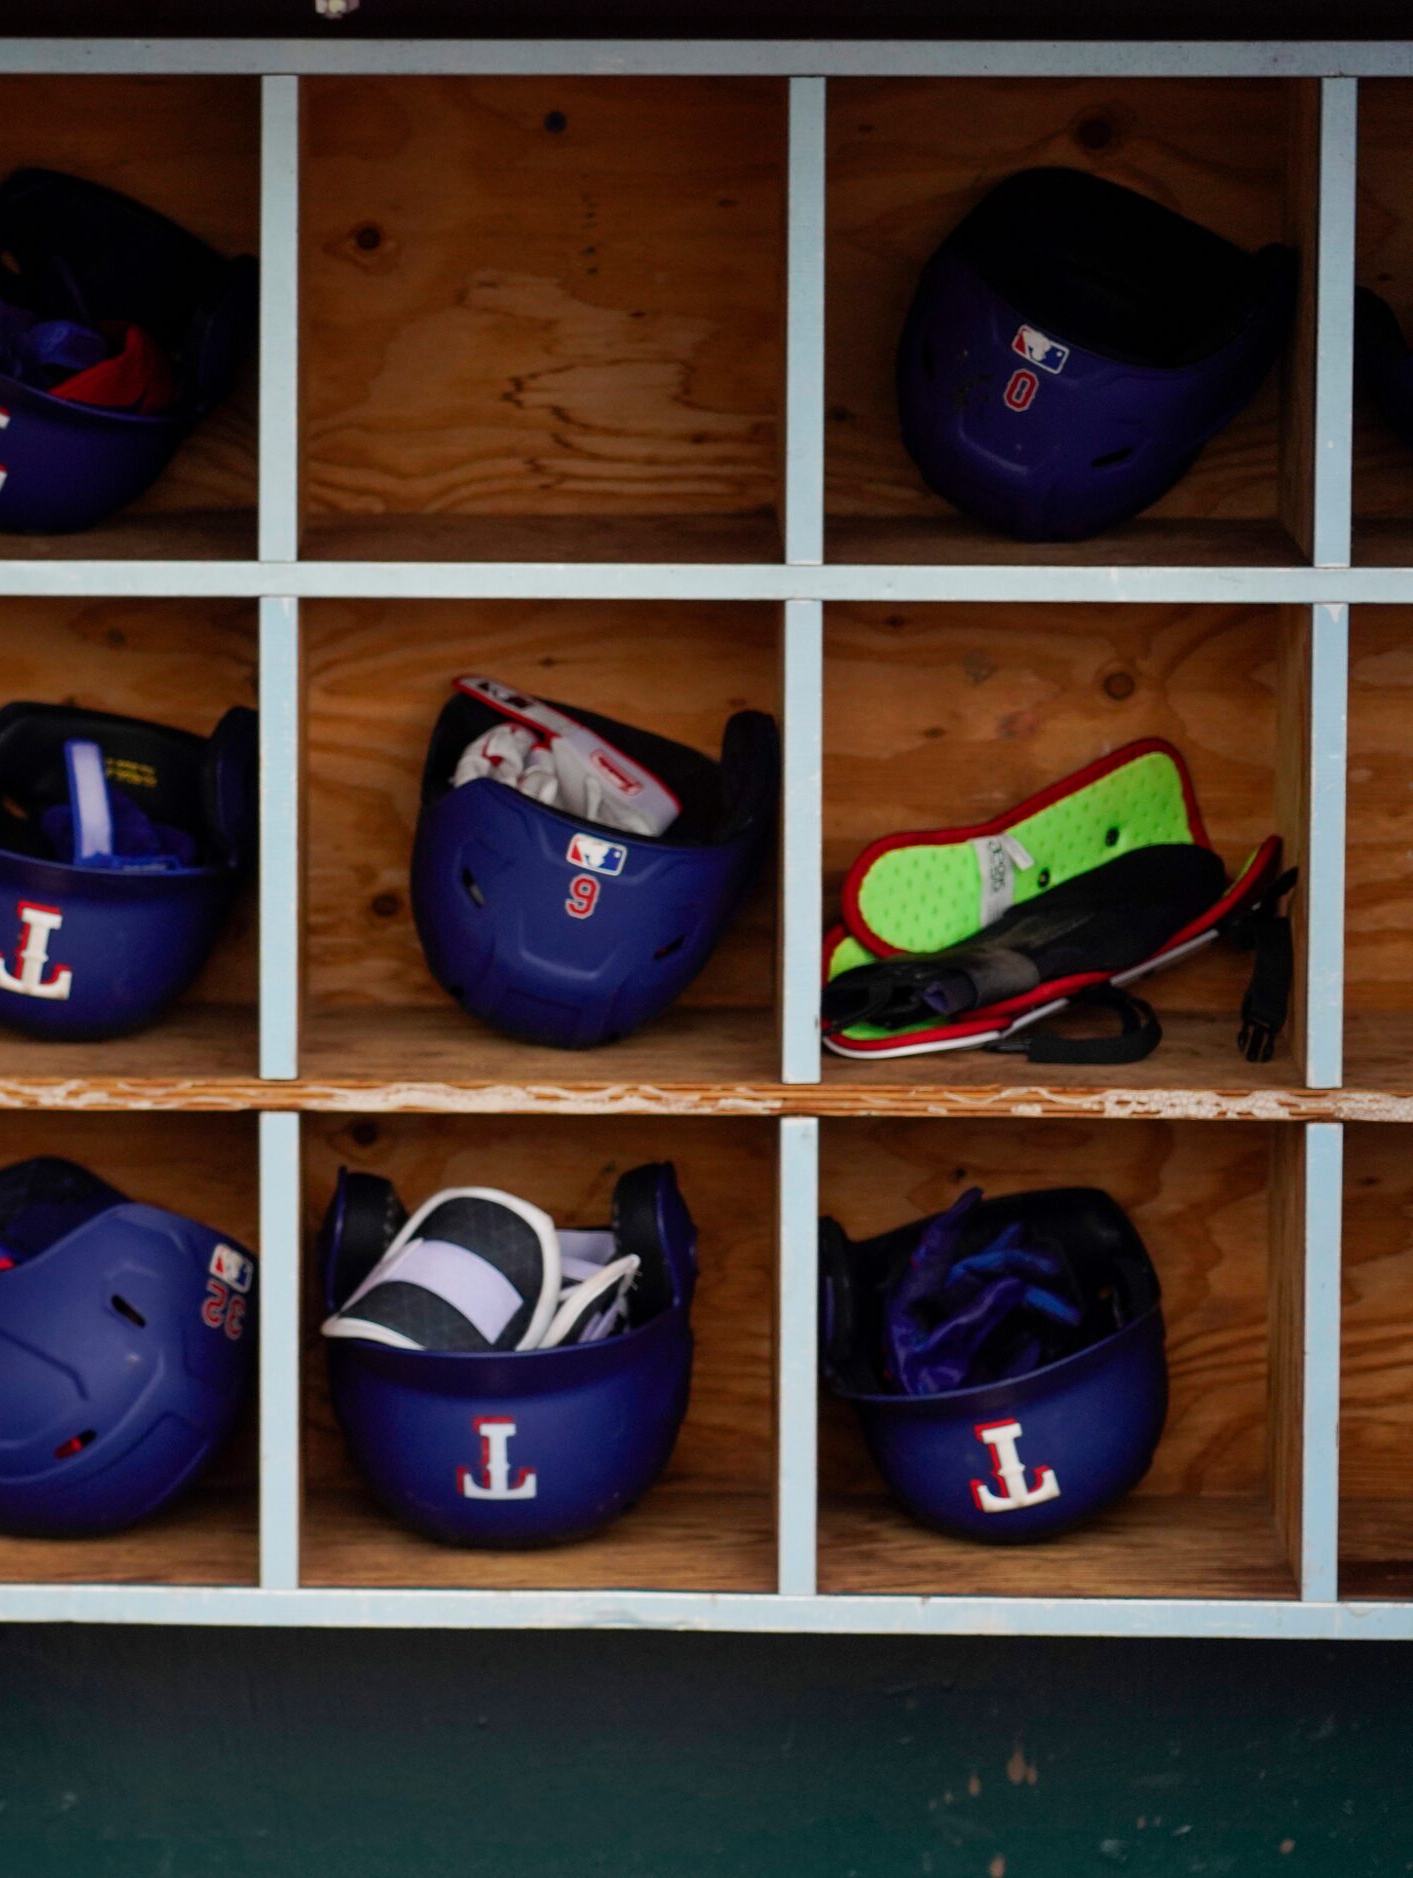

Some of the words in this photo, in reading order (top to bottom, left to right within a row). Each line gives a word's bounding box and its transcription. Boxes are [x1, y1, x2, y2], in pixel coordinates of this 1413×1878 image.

[1002, 367, 1041, 413] 0
[201, 1278, 245, 1341] 32
[456, 1414, 538, 1501] T
[968, 1416, 1061, 1514] T
